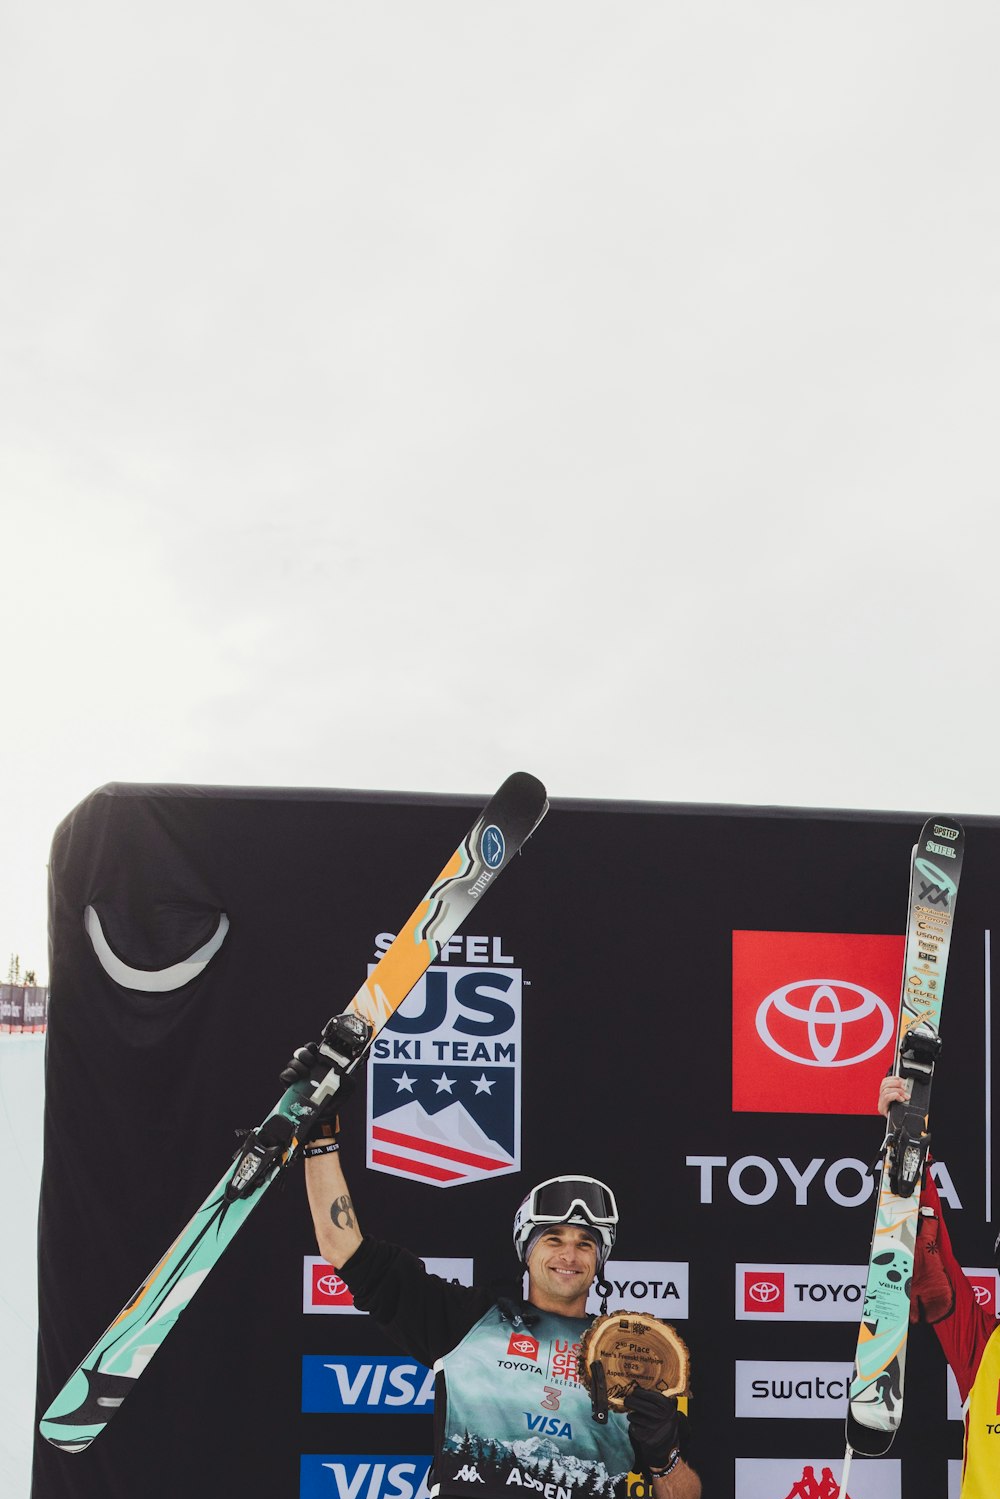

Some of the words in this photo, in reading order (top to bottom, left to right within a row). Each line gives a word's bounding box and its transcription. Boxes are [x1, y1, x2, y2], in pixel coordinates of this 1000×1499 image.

[926, 841, 956, 858] STIFEL
[467, 870, 494, 898] STIFEL
[373, 932, 515, 964] SFEL
[383, 971, 516, 1038] US
[373, 1039, 422, 1060] SKI
[432, 1040, 516, 1063] TEAM
[685, 1154, 963, 1210] TOYOA
[593, 1280, 681, 1300] OYOTA
[794, 1283, 867, 1303] TOYO
[629, 1343, 651, 1354] Place
[496, 1360, 543, 1376] TOYOTA
[606, 1369, 625, 1377] Aspen
[540, 1385, 562, 1411] 3
[523, 1411, 573, 1440] VISA
